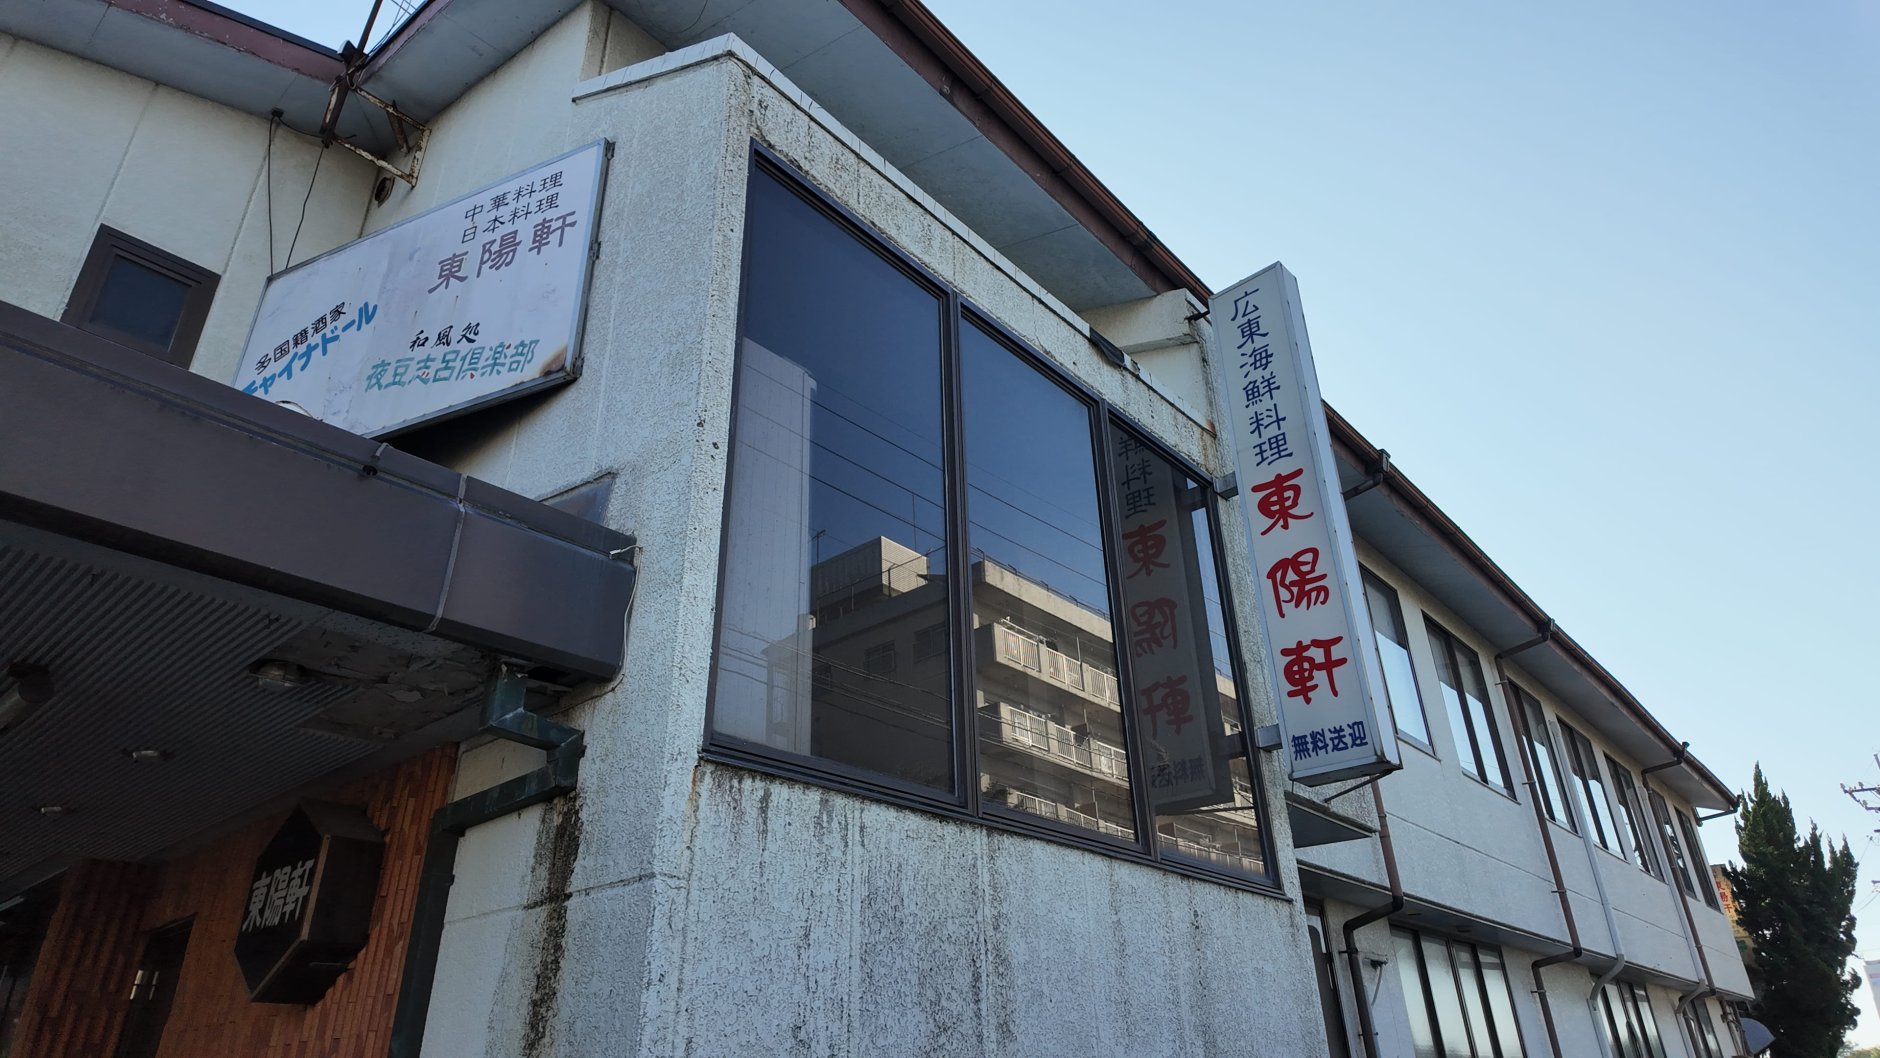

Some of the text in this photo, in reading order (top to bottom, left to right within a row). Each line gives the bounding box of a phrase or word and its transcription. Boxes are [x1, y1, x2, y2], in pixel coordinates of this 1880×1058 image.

[461, 192, 559, 244] 日本料理
[464, 171, 563, 222] 中華料理
[428, 210, 578, 294] 東陽軒
[255, 302, 347, 375] 多国籍酒家
[409, 322, 481, 352] 和風処
[1230, 288, 1294, 467] 広東海鮮料理
[1251, 467, 1348, 706] 東陽軒
[1291, 720, 1369, 761] 無料送迎
[241, 858, 315, 932] 東陽軒
